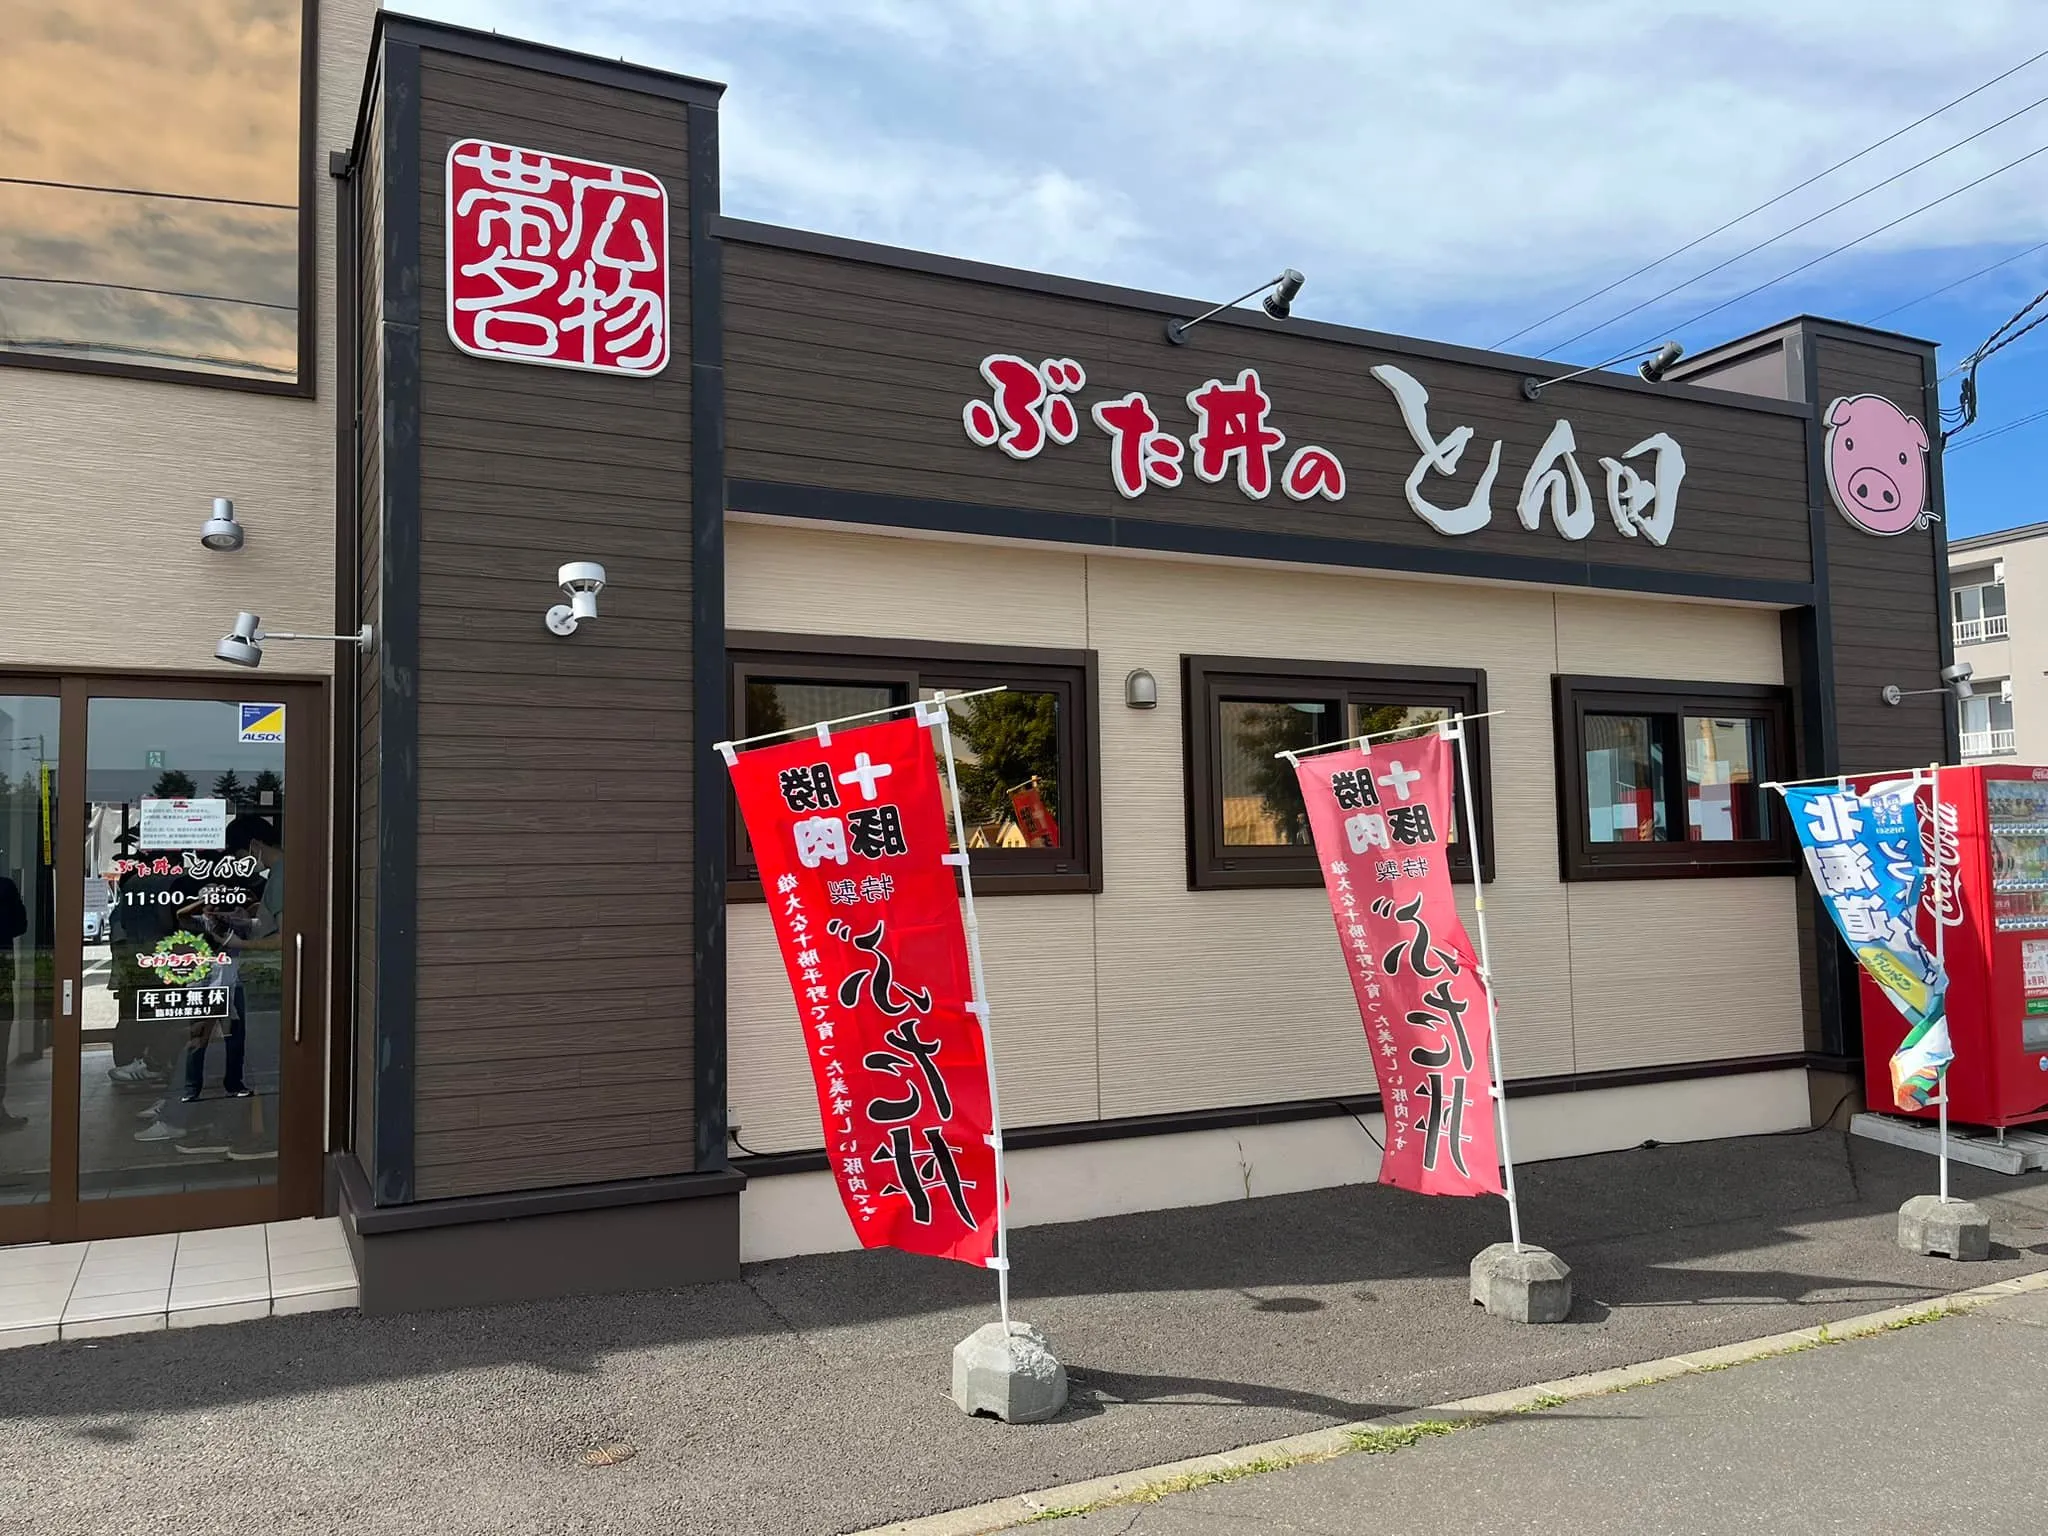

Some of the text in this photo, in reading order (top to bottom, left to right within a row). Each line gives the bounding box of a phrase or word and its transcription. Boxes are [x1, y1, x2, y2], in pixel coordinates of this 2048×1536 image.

[455, 246, 664, 369] 名物
[963, 353, 1686, 547] ぶた丼の とん田
[242, 733, 282, 741] ALSOK
[181, 852, 257, 880] とん田
[136, 952, 232, 968] とかちチャーム
[142, 990, 226, 1008] 年中無休
[155, 1006, 212, 1018] 臨時休業あり
